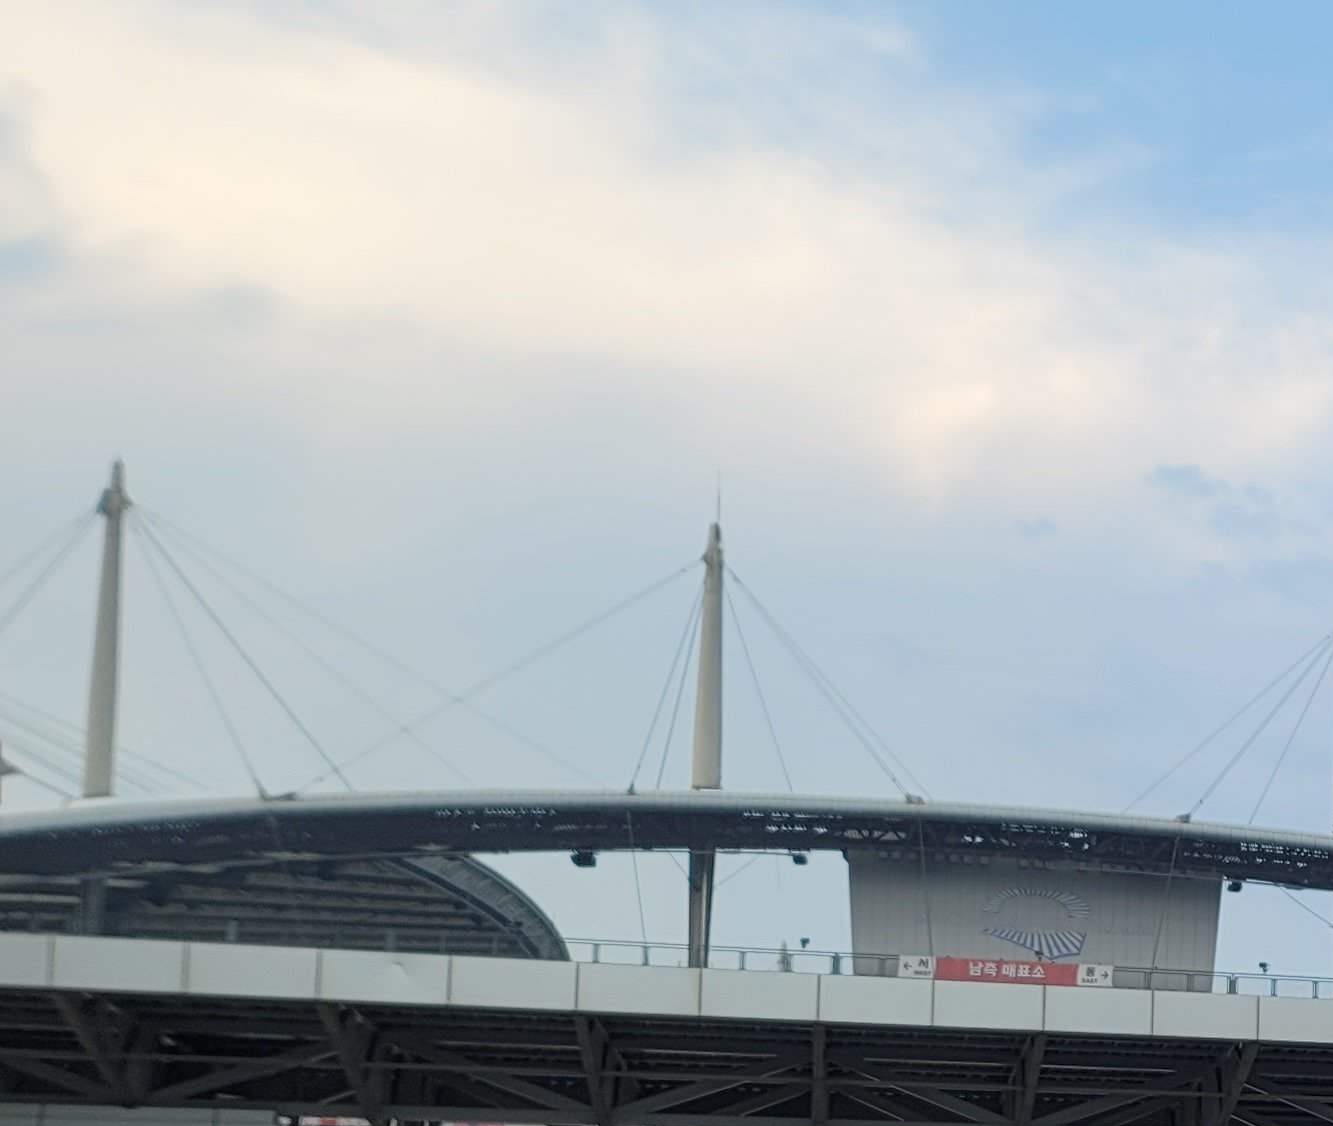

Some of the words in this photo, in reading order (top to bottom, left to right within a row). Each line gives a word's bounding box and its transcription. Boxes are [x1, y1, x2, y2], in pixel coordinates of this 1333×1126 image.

[918, 959, 929, 970] 서
[968, 961, 998, 977] 남측
[1002, 963, 1046, 978] 매표소
[1086, 966, 1097, 978] 동
